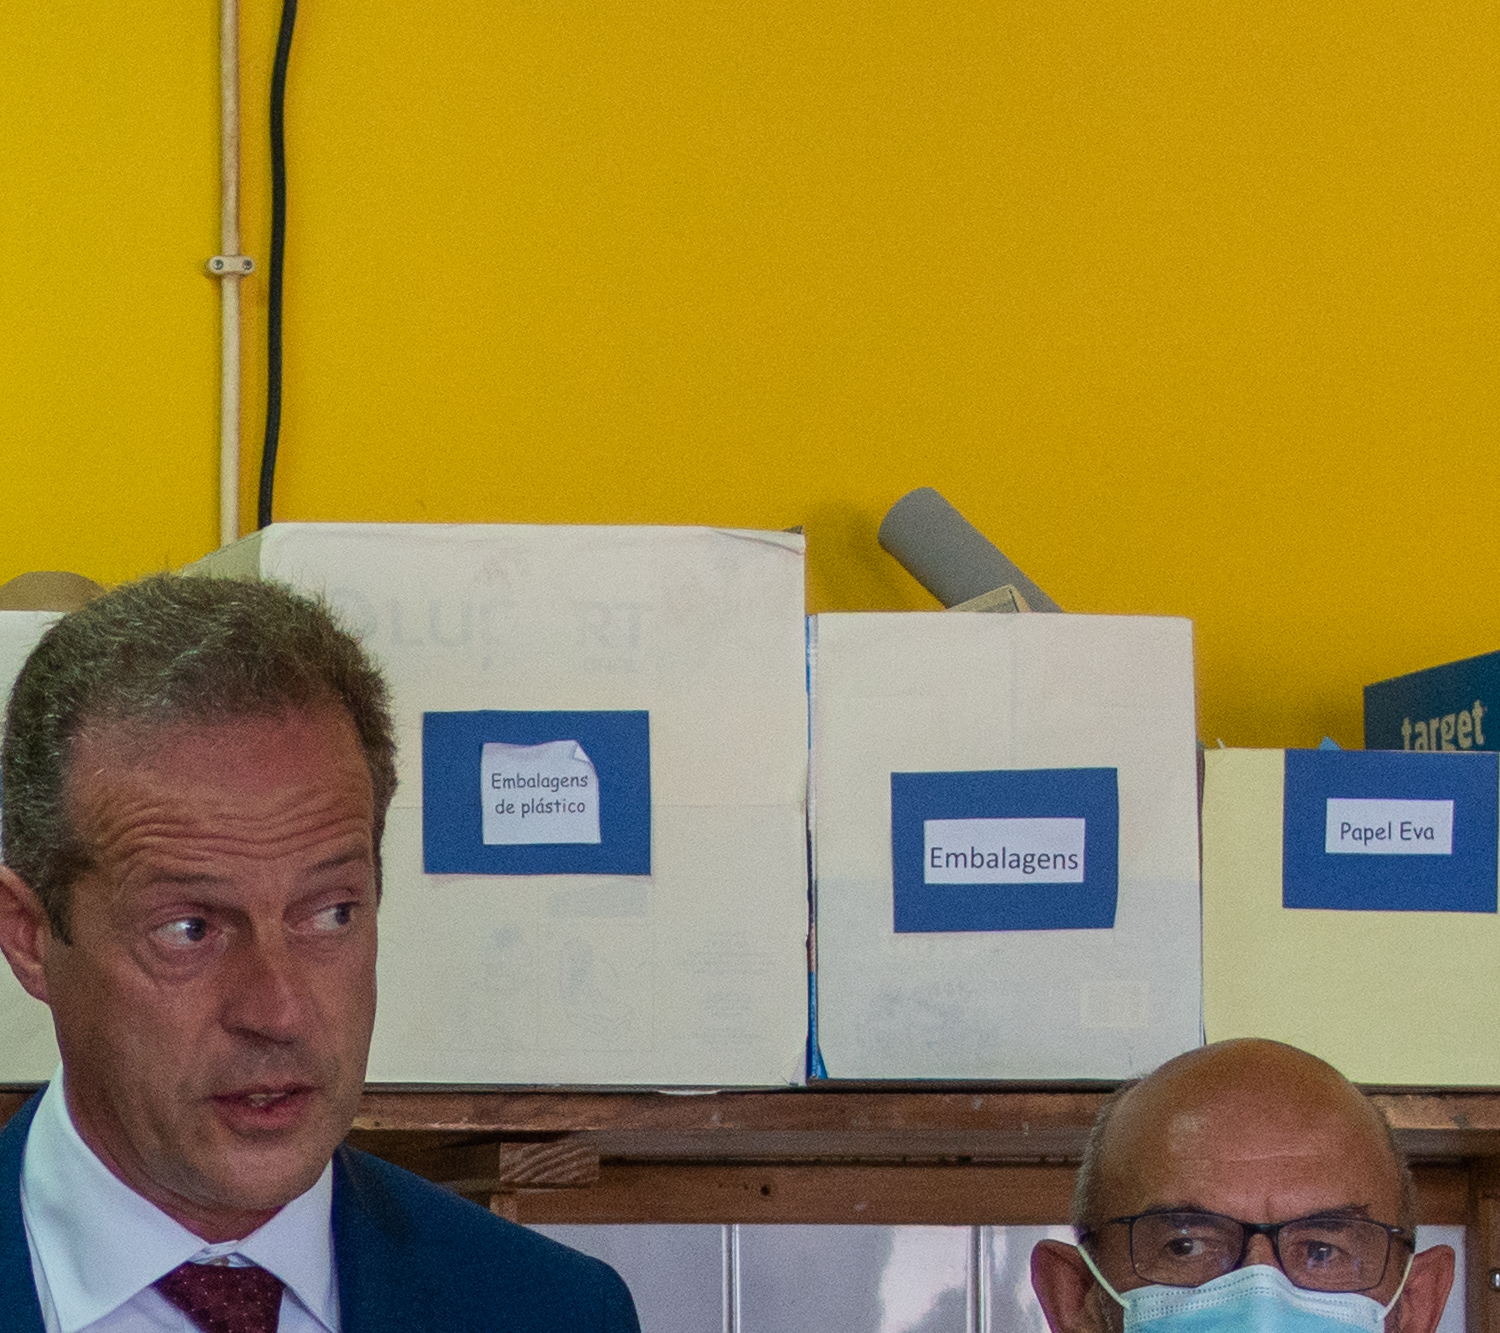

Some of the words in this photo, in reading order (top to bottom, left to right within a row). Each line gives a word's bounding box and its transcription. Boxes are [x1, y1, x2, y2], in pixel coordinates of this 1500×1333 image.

[1401, 699, 1486, 750] target
[490, 770, 589, 796] Embalagens
[494, 798, 518, 816] de
[520, 795, 587, 820] plástico
[1339, 819, 1393, 847] Papel
[1399, 820, 1436, 843] Eva
[928, 843, 1080, 877] Embalagens
